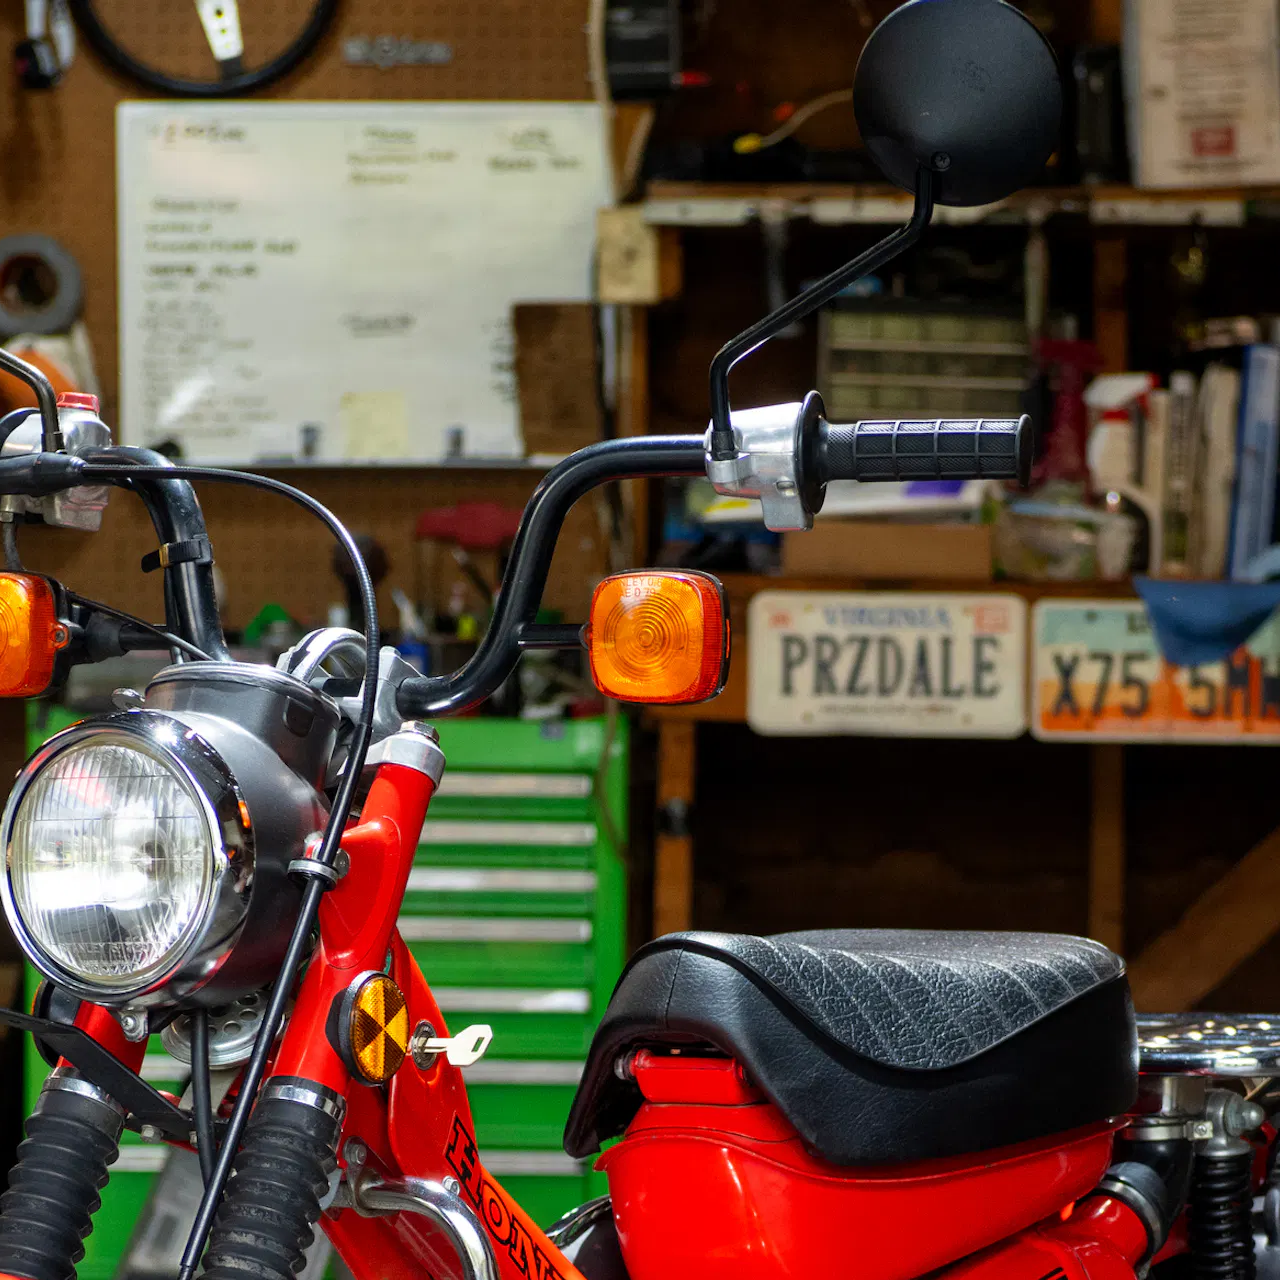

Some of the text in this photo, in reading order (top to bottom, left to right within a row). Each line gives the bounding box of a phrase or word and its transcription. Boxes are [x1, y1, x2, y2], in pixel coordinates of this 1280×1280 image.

[823, 606, 952, 629] VIRGINIA
[780, 633, 1003, 698] PRZDALE
[1052, 651, 1150, 717] X75
